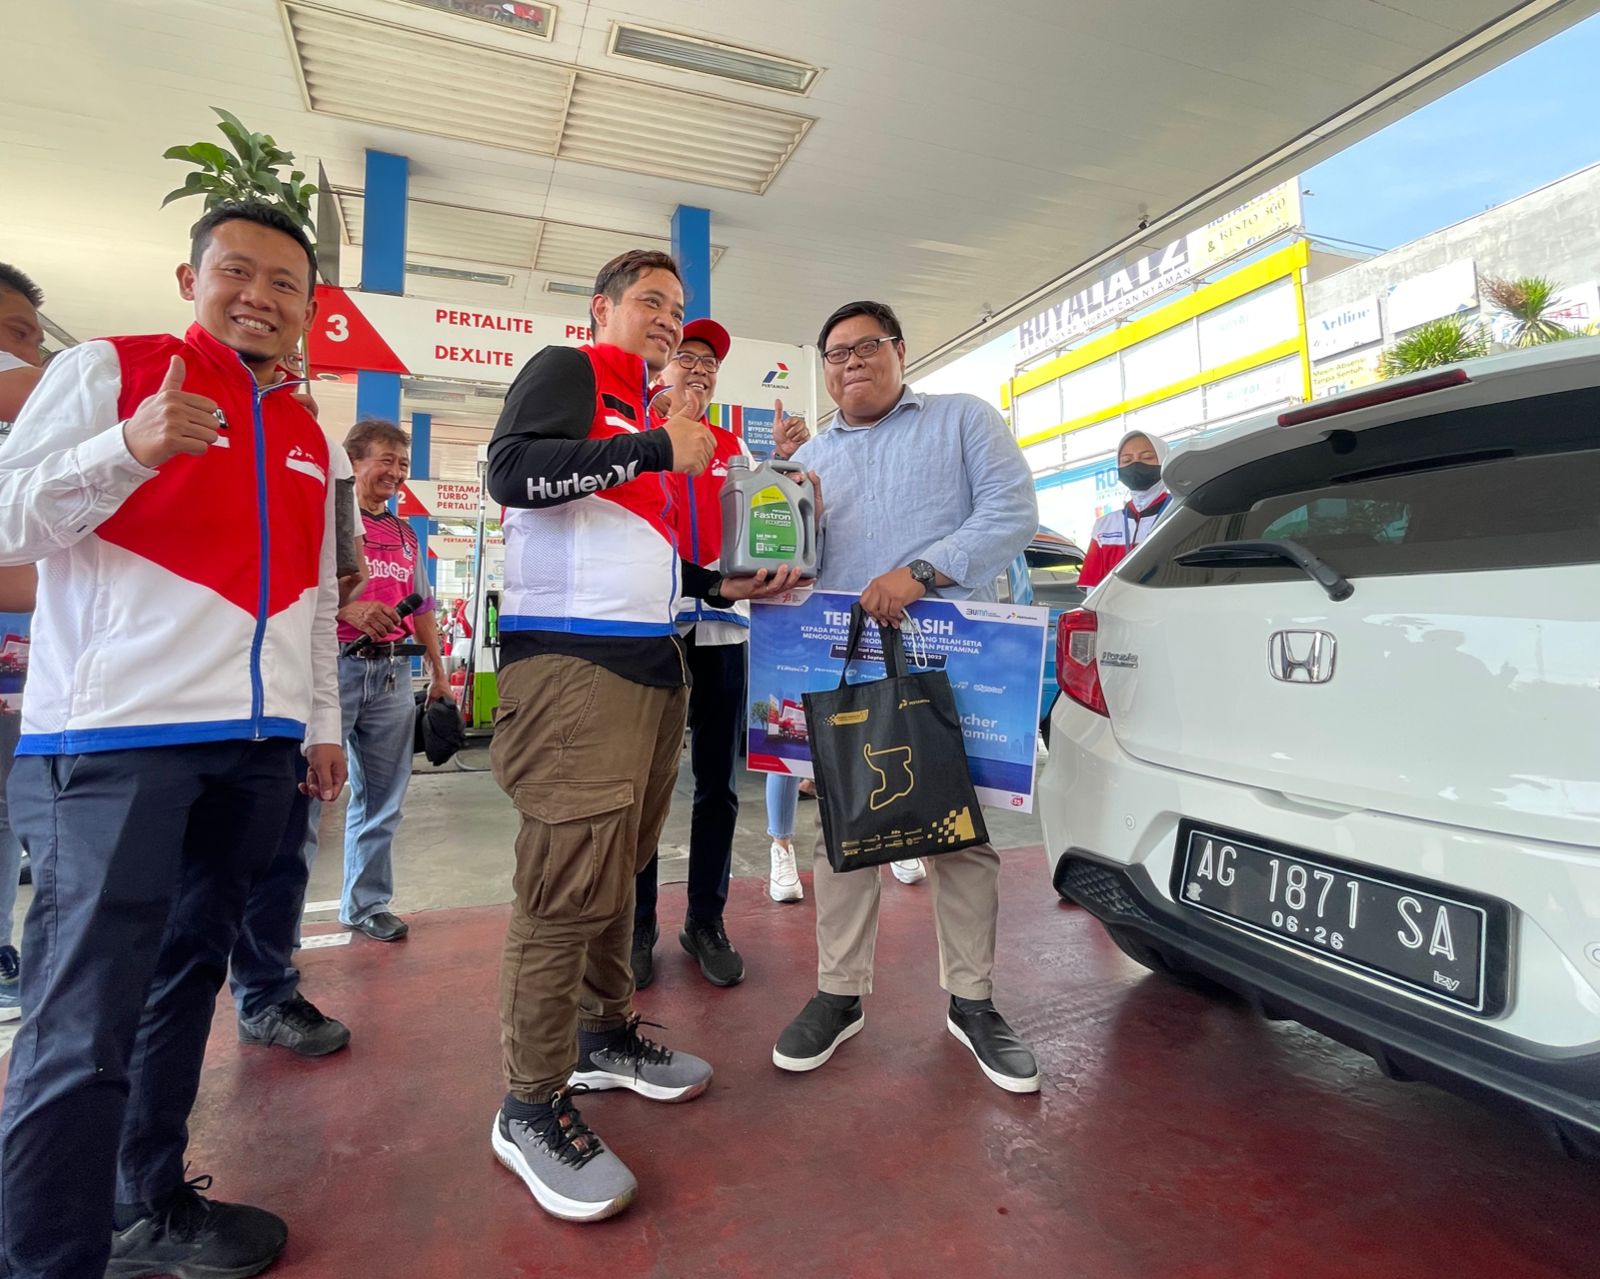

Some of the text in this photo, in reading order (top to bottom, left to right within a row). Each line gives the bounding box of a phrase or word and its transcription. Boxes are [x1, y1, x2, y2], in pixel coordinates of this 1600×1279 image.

[1118, 293, 1139, 311] DAN
[1142, 267, 1192, 297] NYAMAN
[325, 314, 350, 342] 3
[436, 309, 533, 334] PERTALITE
[435, 345, 513, 367] DEXLITE
[397, 490, 407, 504] 2
[437, 484, 480, 494] PERTAMA
[437, 492, 468, 501] TURBO
[527, 471, 613, 501] Hurley
[436, 501, 478, 511] PERTALIT
[753, 511, 791, 521] Fastron
[364, 556, 388, 578] ght
[800, 625, 828, 634] KEPADA
[938, 636, 961, 646] TELAH
[961, 639, 983, 649] SETIA
[802, 632, 849, 643] MENGGUNAK
[935, 645, 980, 655] PERTAMINA
[1196, 839, 1457, 962] AG 1871 SA
